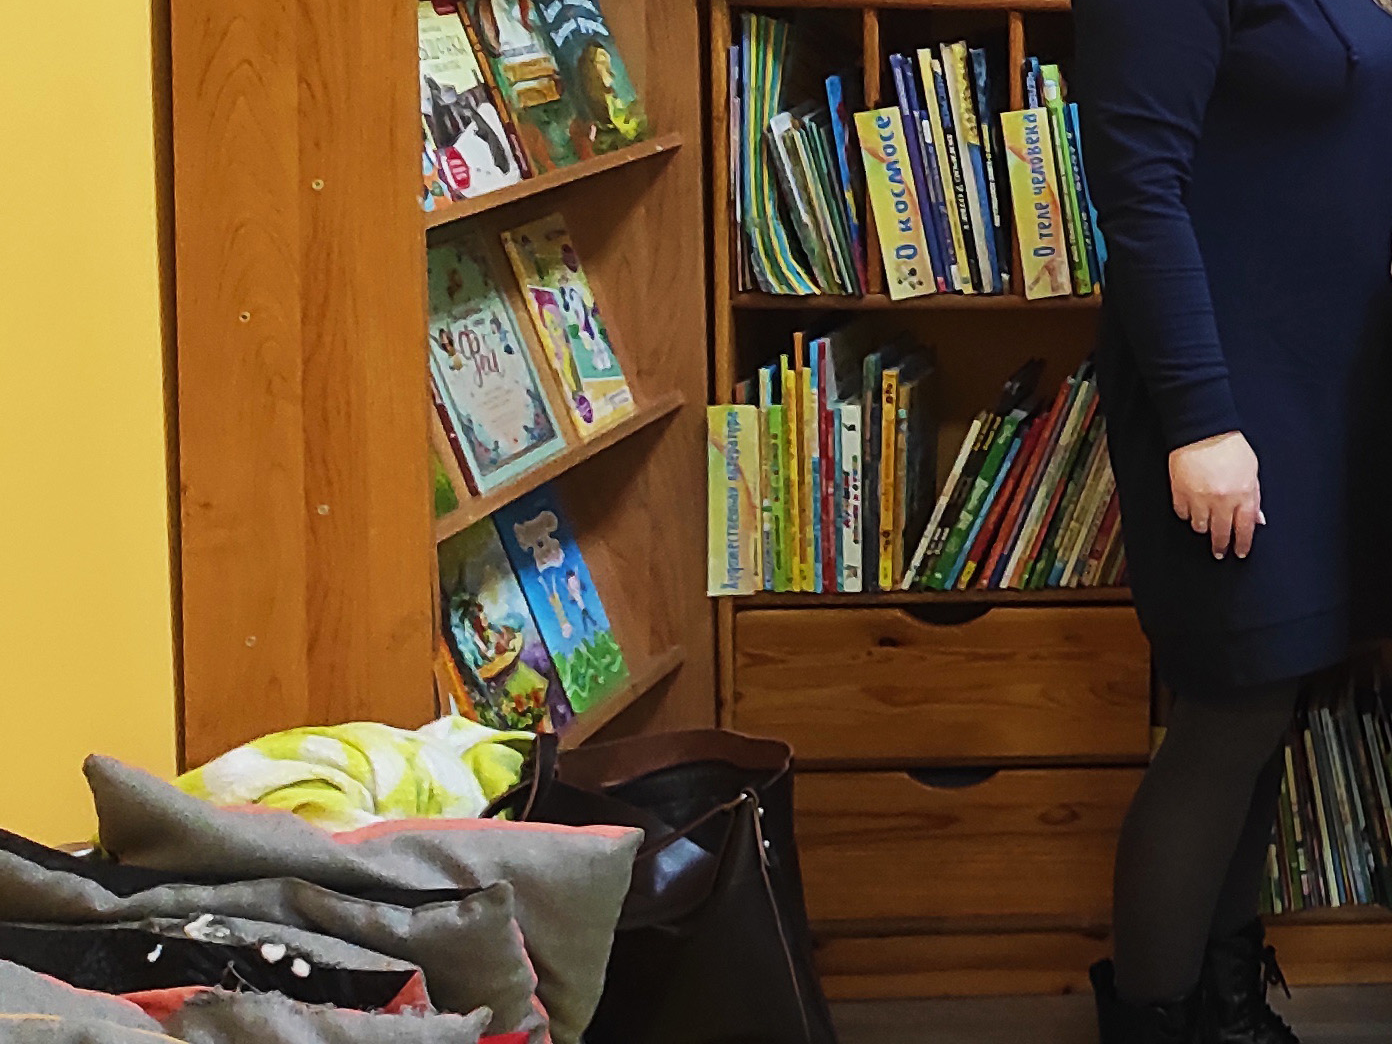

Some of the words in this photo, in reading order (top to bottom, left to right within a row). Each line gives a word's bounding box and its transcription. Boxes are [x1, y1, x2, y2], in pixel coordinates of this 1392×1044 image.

[875, 113, 912, 233] космосе
[1025, 114, 1046, 195] человека
[1034, 201, 1052, 240] теле
[894, 242, 918, 261] О
[1033, 245, 1055, 257] О
